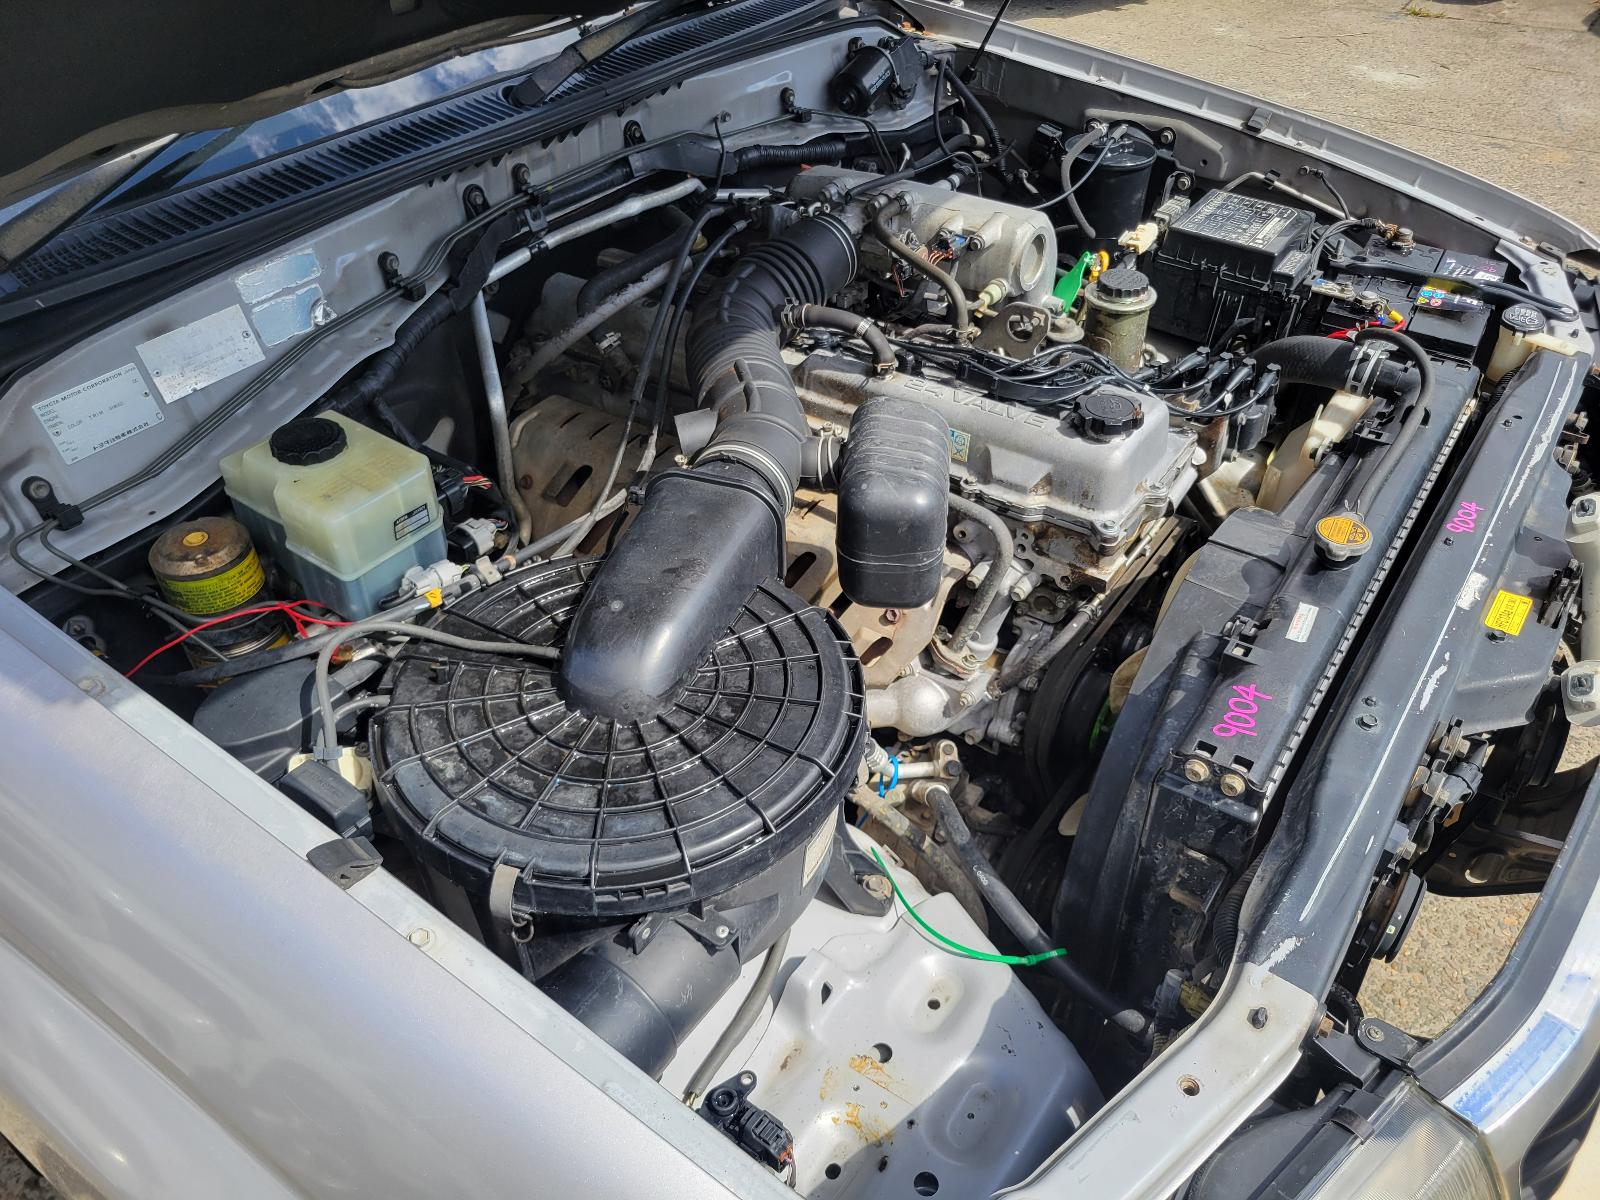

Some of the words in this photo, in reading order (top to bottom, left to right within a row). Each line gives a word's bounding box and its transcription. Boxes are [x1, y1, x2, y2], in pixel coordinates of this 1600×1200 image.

[38, 399, 59, 411] TOYOTA
[61, 389, 82, 401] MOTOR
[82, 371, 123, 392] CORPORATION
[953, 390, 1048, 428] VALVE
[1446, 501, 1485, 533] 9004
[1212, 683, 1272, 737] 9004
